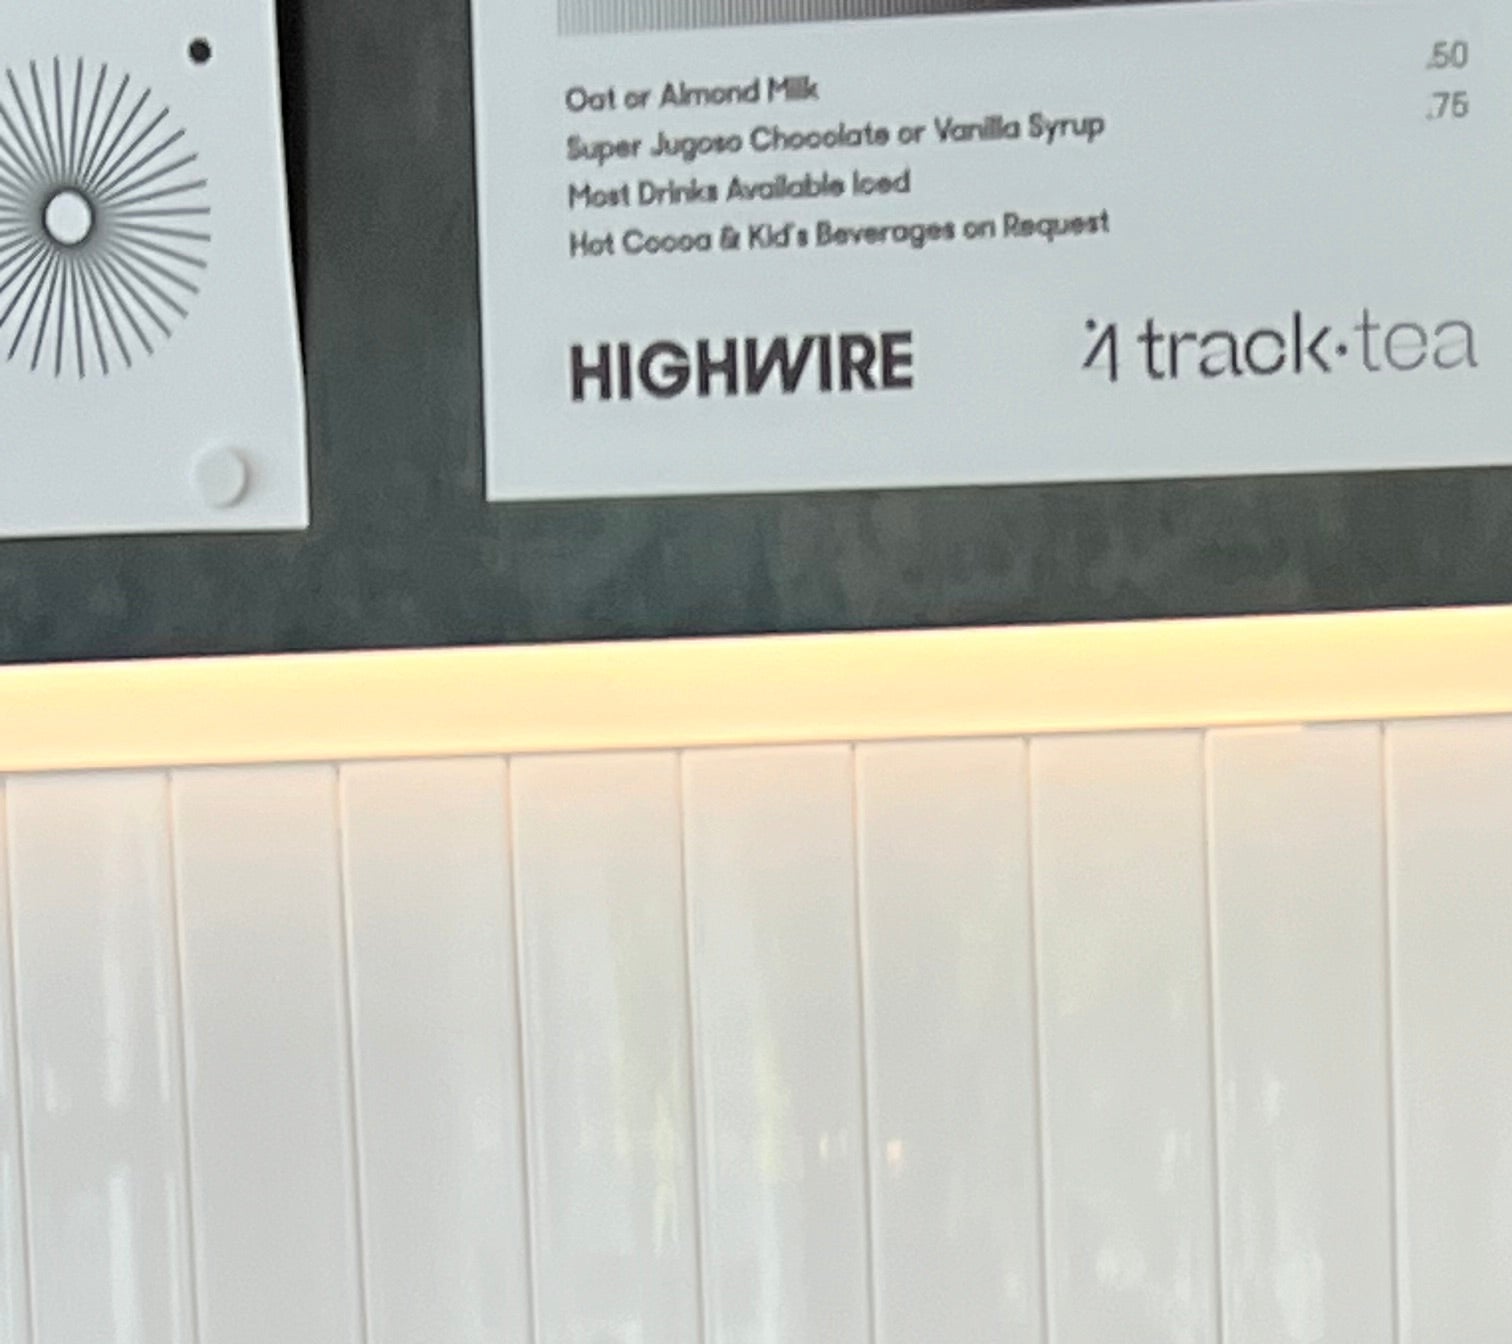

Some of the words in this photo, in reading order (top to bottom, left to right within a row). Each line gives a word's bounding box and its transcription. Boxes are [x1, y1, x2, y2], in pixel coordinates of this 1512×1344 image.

[565, 85, 616, 112] Oat
[623, 88, 650, 109] or
[658, 77, 760, 108] Almond
[767, 74, 819, 103] Milk
[566, 133, 641, 167] Super
[750, 121, 890, 152] Chocolate
[897, 125, 925, 144] or
[934, 114, 1020, 143] Vanilla
[1028, 111, 1105, 145] Syrup
[568, 182, 630, 210] Most
[638, 177, 718, 206] Drinks
[726, 169, 845, 203] Available
[852, 163, 911, 196] Iced
[569, 230, 615, 258] Hot
[621, 227, 713, 255] Cocoa
[719, 223, 741, 250] &
[748, 221, 809, 250] Kid's
[815, 217, 956, 250] Beverages
[962, 219, 996, 241] on
[1003, 208, 1109, 242] Request
[570, 330, 914, 401] HIGHWIRE
